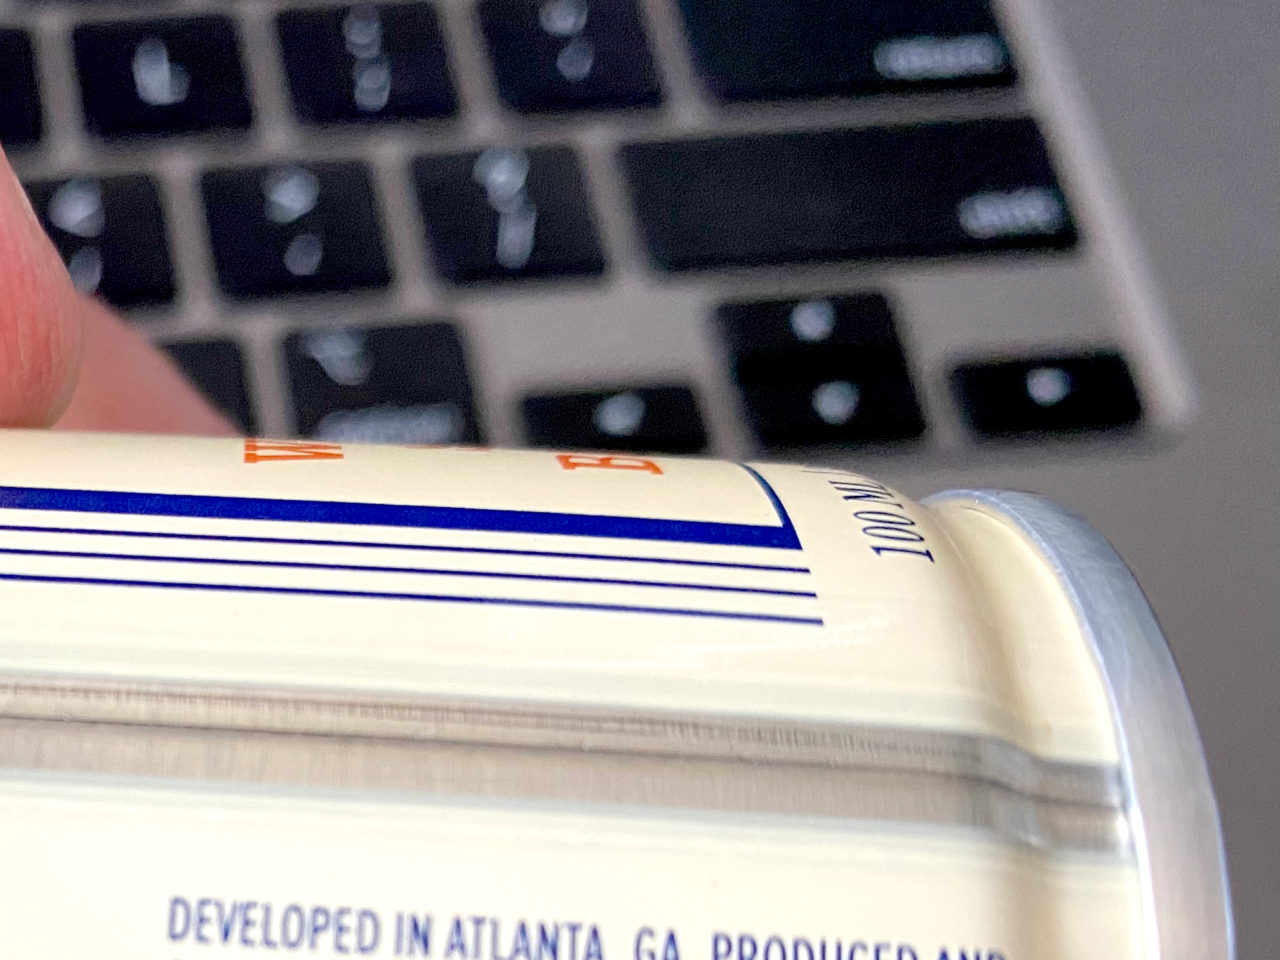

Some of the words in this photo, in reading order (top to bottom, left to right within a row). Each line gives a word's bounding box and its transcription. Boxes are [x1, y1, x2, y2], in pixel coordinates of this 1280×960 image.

[852, 511, 934, 563] 100
[167, 895, 381, 955] DEVELOPED
[393, 910, 433, 958] IN
